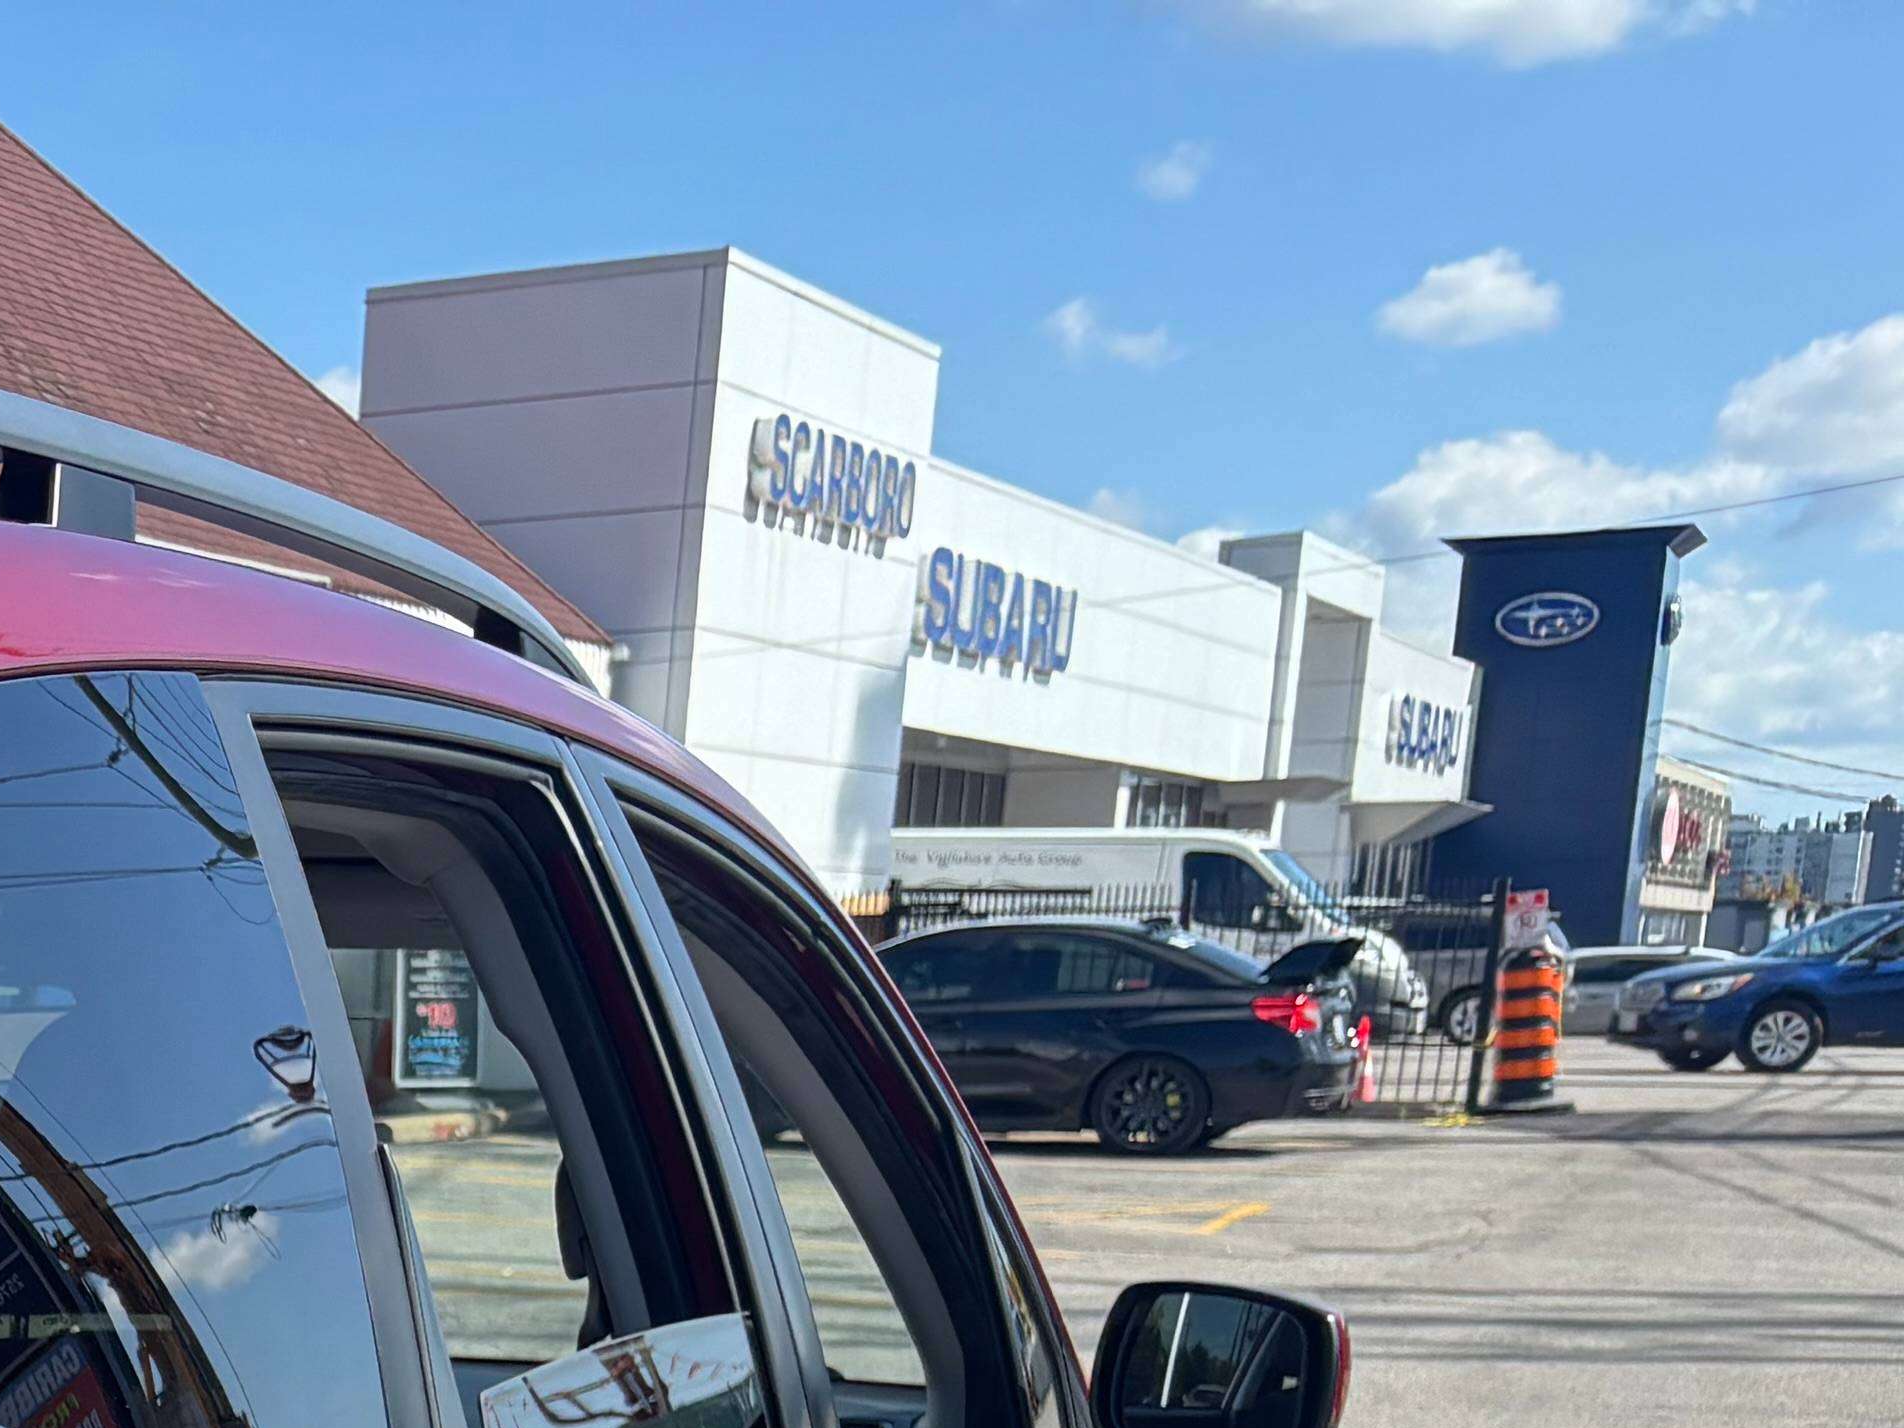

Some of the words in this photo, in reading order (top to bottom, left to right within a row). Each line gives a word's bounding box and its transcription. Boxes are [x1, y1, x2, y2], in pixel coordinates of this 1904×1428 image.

[769, 413, 917, 539] SCARBORO
[924, 547, 1078, 673] SUBARU
[1397, 693, 1463, 767] SUBARU
